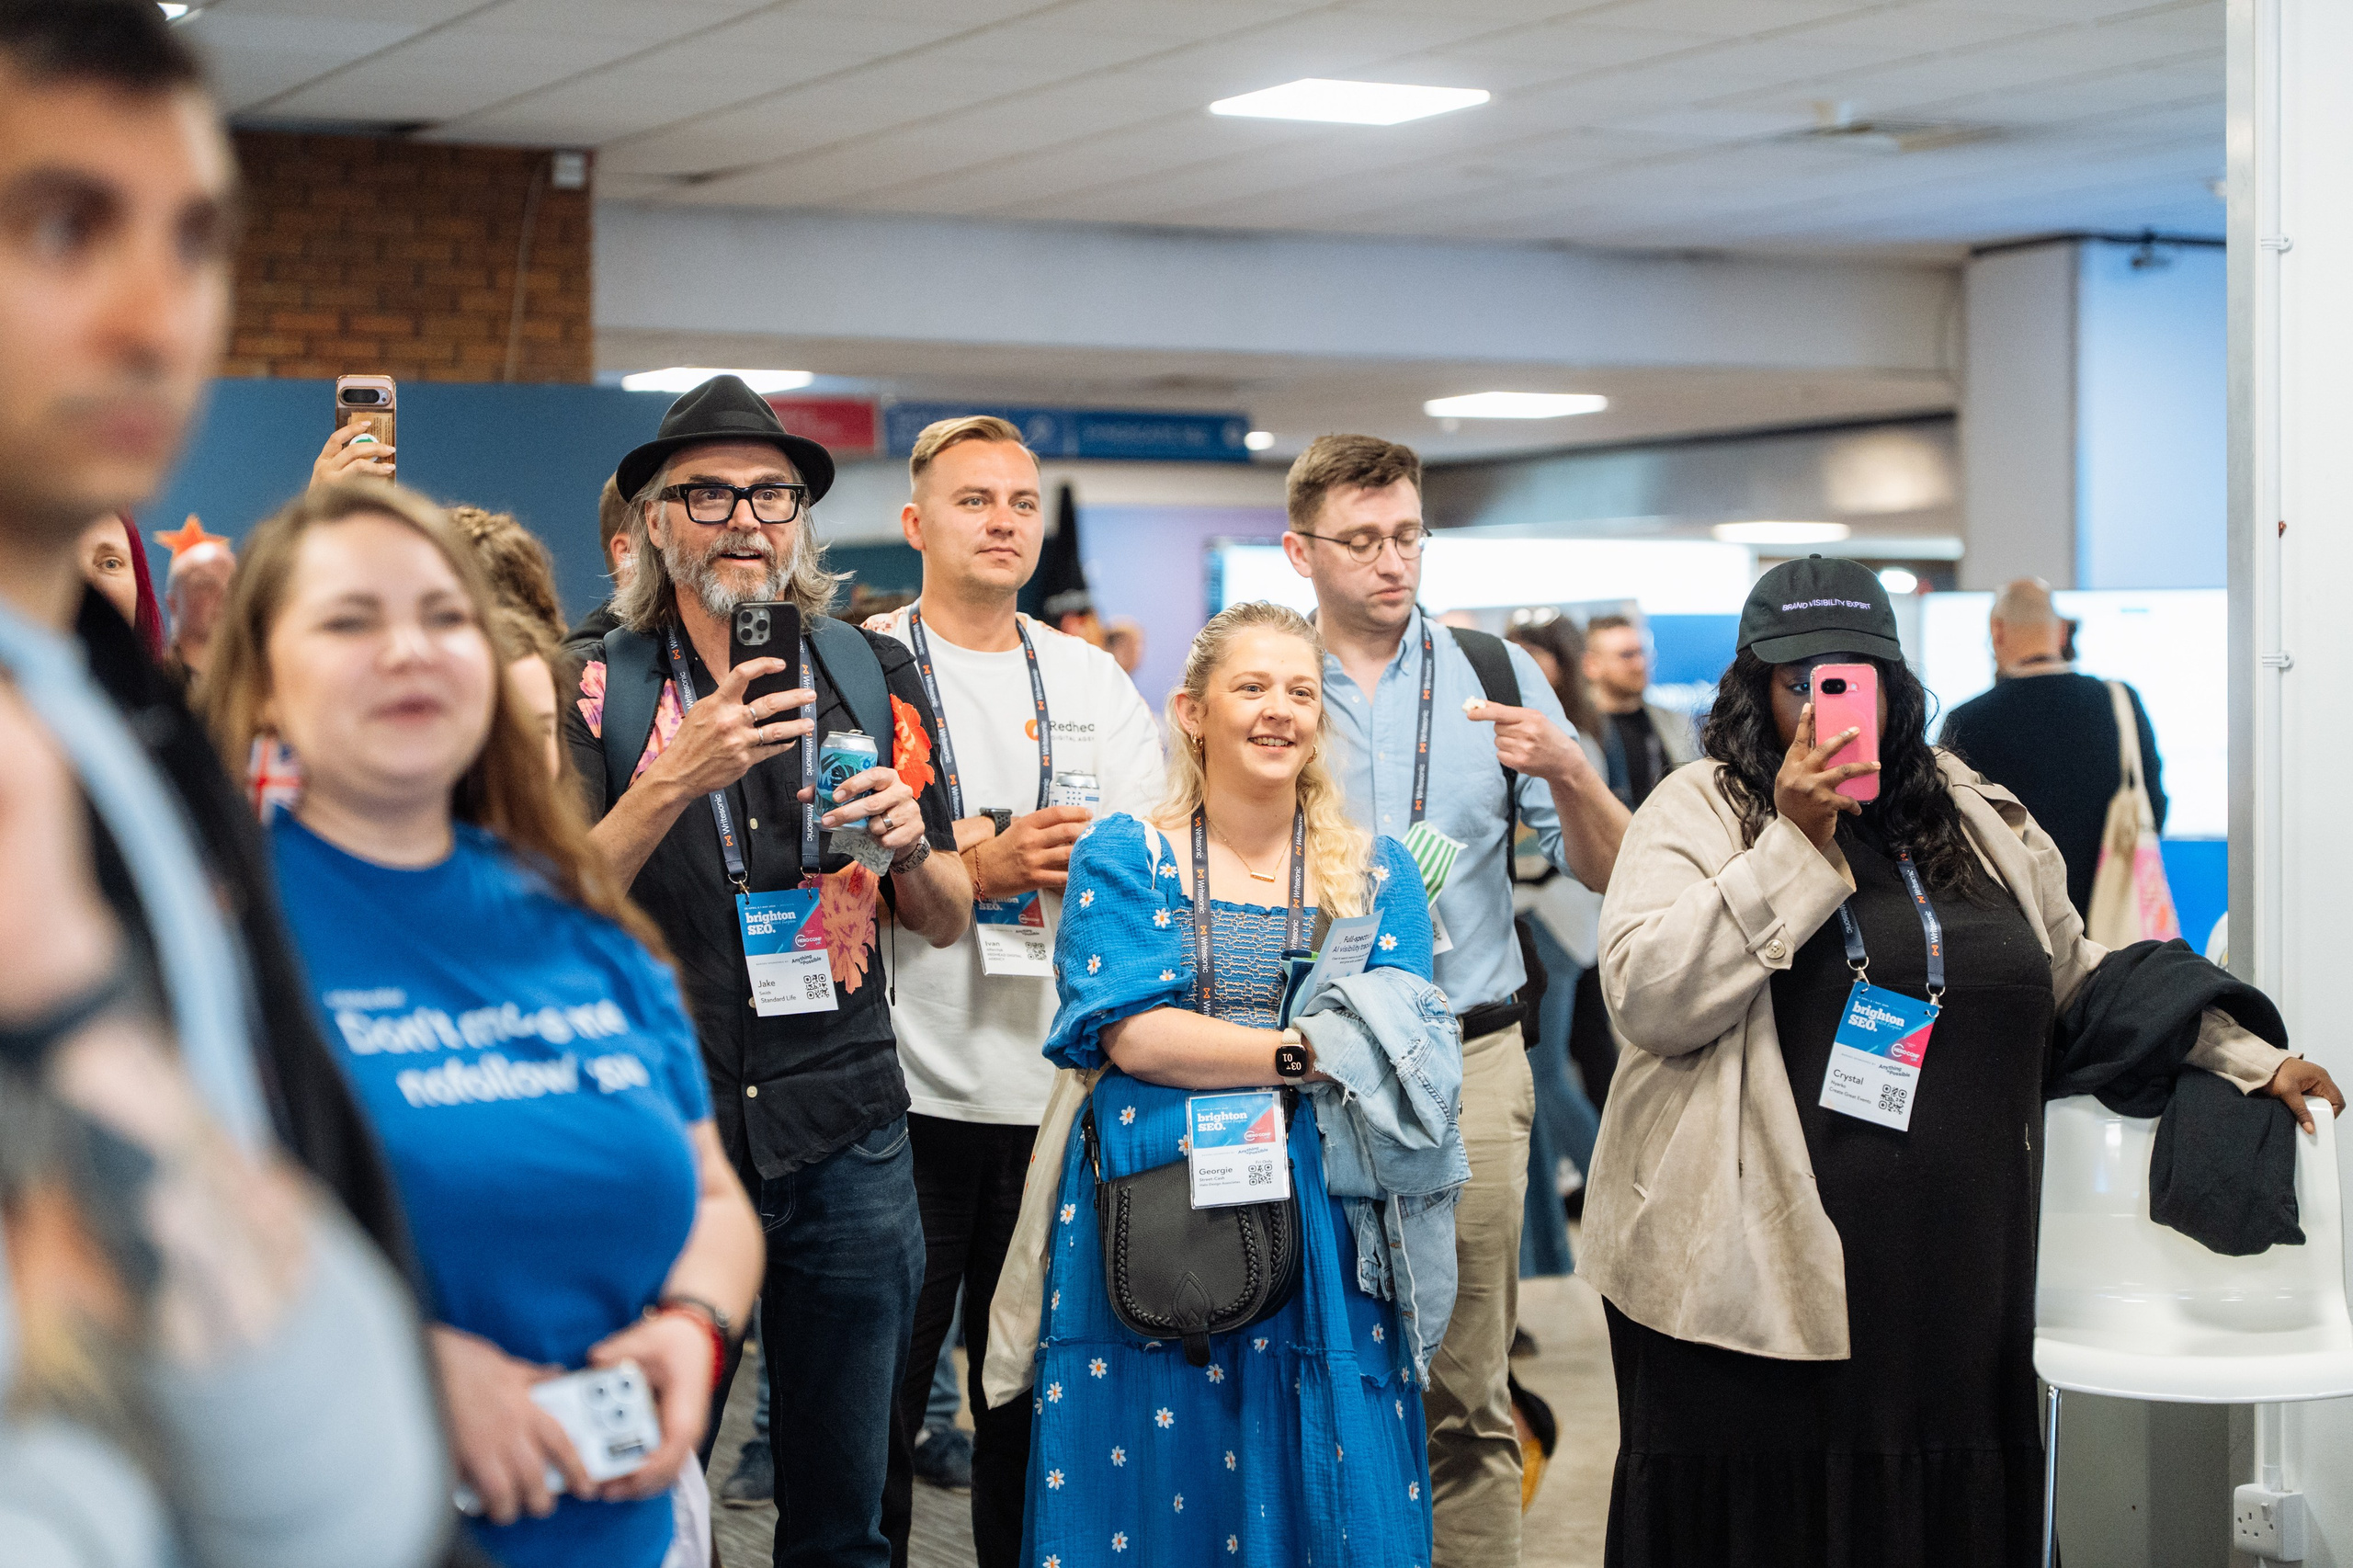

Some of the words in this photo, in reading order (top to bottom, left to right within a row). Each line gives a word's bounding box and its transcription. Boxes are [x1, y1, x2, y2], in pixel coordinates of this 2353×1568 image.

[1782, 601, 1808, 611] BRAND
[1809, 598, 1846, 607] VISIBILITY
[1846, 600, 1871, 609] EXPERT
[715, 794, 730, 835] Writesonic
[1293, 866, 1302, 898] Writesonic
[1197, 880, 1205, 915] Writesonic
[745, 910, 796, 925] brighton
[747, 924, 776, 936] SEO.
[791, 954, 813, 963] Anything
[802, 956, 822, 965] Possible
[1199, 936, 1208, 973] Writesonic
[757, 980, 776, 988] Jake
[1852, 1001, 1905, 1028] brighton
[1848, 1014, 1878, 1032] SEO.
[1833, 1069, 1864, 1085] Crystal
[1198, 1111, 1248, 1123] brighton
[1198, 1122, 1226, 1132] SEO.
[1199, 1166, 1233, 1176] Georgie
